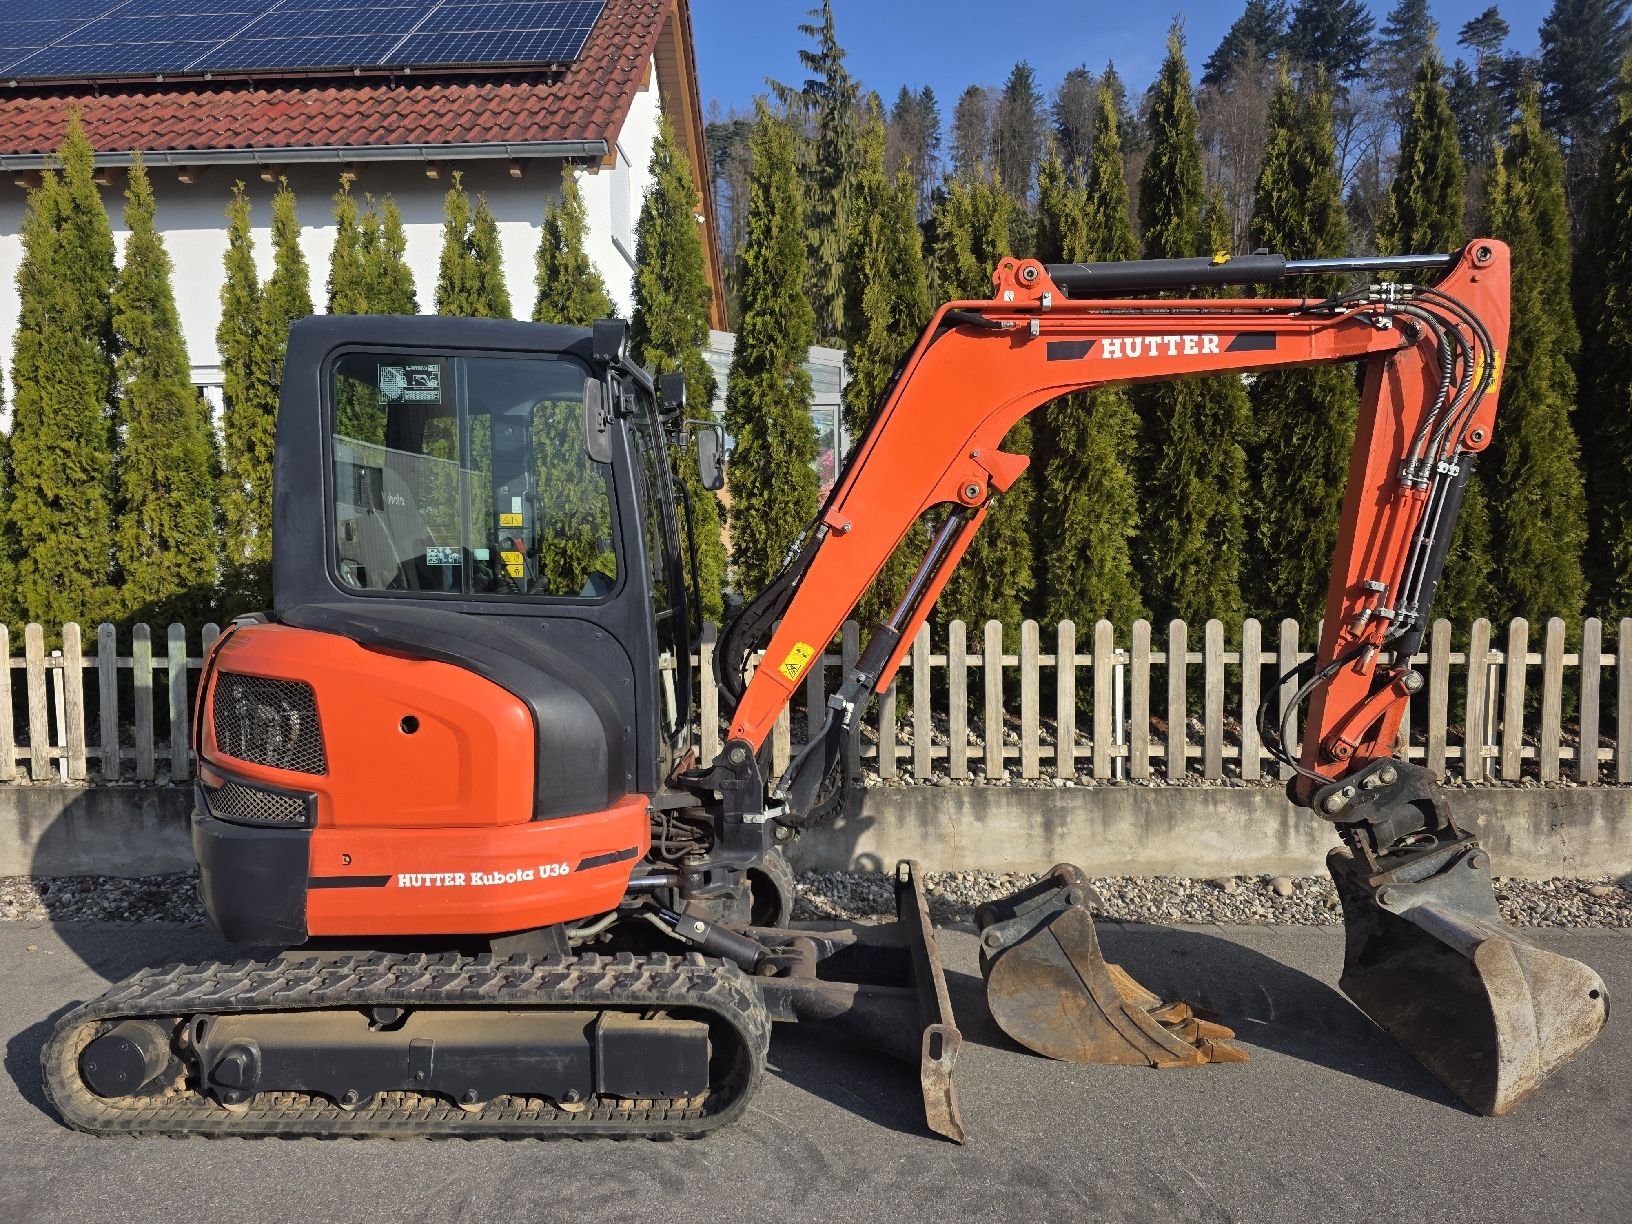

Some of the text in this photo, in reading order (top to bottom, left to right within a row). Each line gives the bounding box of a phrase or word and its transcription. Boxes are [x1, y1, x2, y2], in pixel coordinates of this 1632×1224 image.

[1101, 334, 1220, 359] HUTTER
[397, 862, 570, 888] HUTTER Kubota U36
